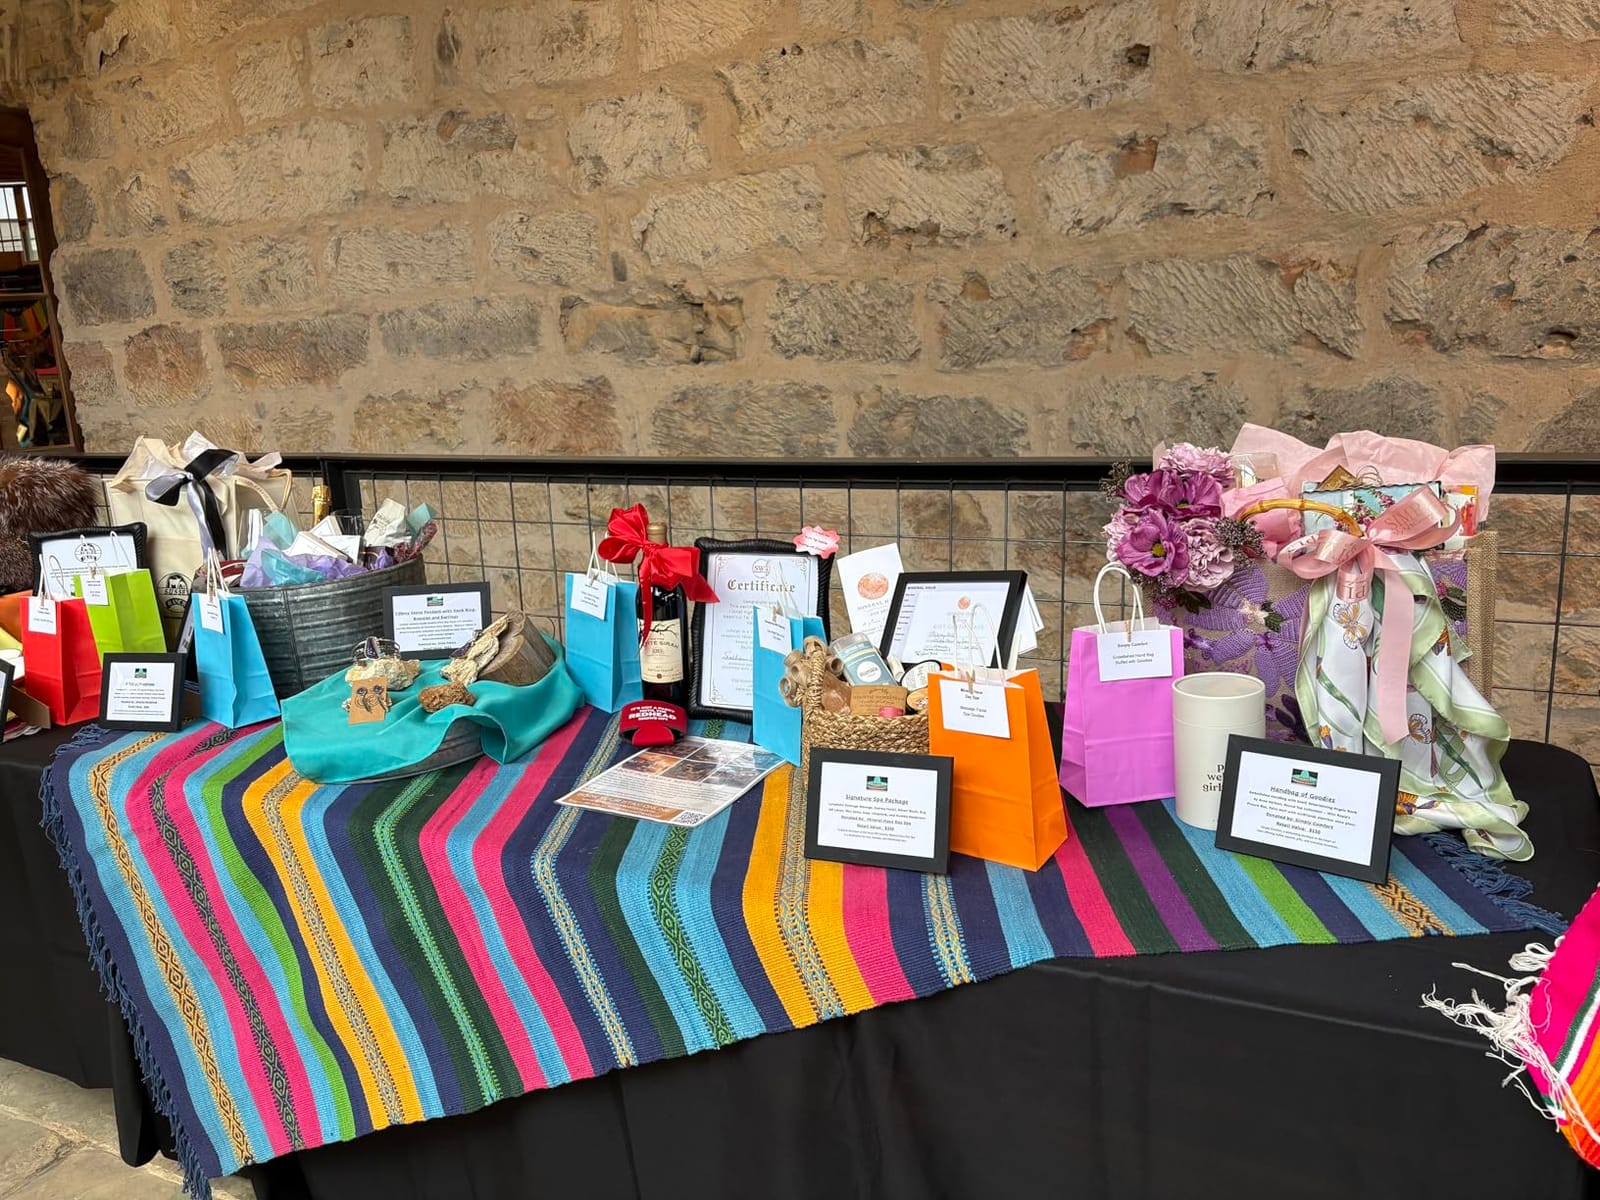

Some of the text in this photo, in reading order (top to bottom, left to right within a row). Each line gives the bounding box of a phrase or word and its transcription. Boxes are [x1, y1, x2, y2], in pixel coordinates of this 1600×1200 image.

[727, 579, 796, 593] Certificate
[628, 712, 677, 720] REDHEAD
[845, 794, 908, 805] Signature Spa Package
[1270, 786, 1335, 803] Handbag of Goodies
[1266, 812, 1287, 821] Donated
[1295, 817, 1312, 826] Simply
[1312, 821, 1334, 831] Comfort
